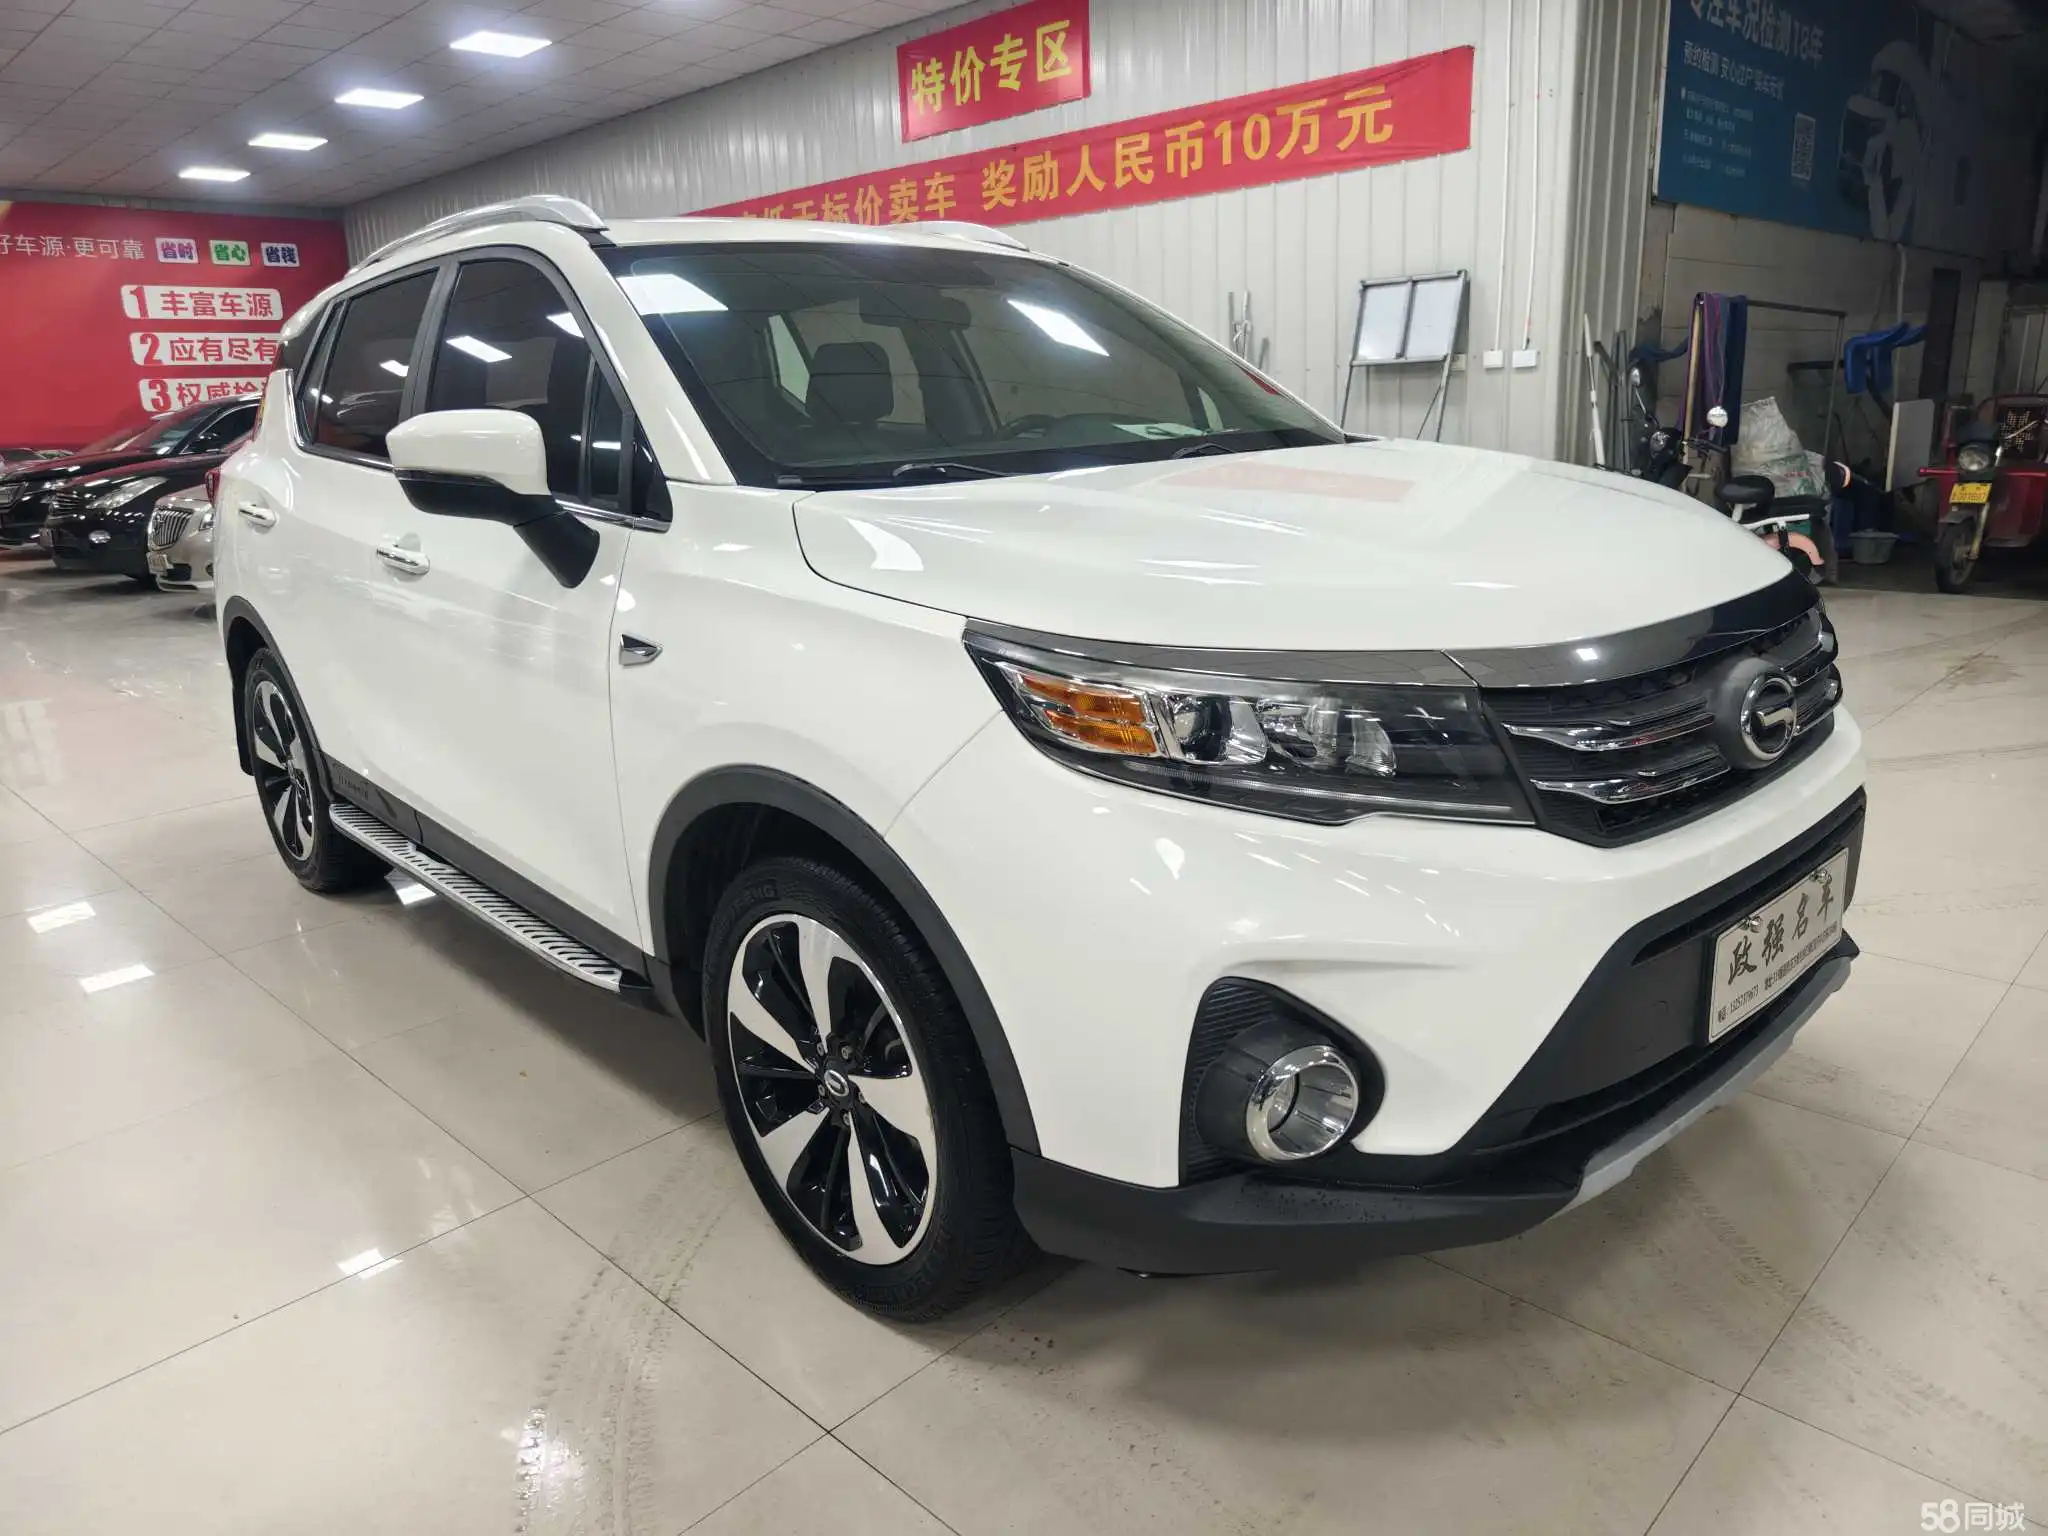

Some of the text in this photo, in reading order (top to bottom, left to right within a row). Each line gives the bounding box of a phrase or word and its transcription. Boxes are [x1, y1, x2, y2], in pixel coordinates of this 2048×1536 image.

[911, 19, 1072, 115] 特价专区
[981, 84, 1394, 211] 奖励人民币10万元
[161, 242, 195, 260] 省时
[214, 243, 246, 261] 省心
[265, 245, 297, 264] 省钱
[129, 286, 273, 319] 1 丰富车源
[140, 333, 277, 365] 2 应有尽有
[148, 379, 172, 411] 3
